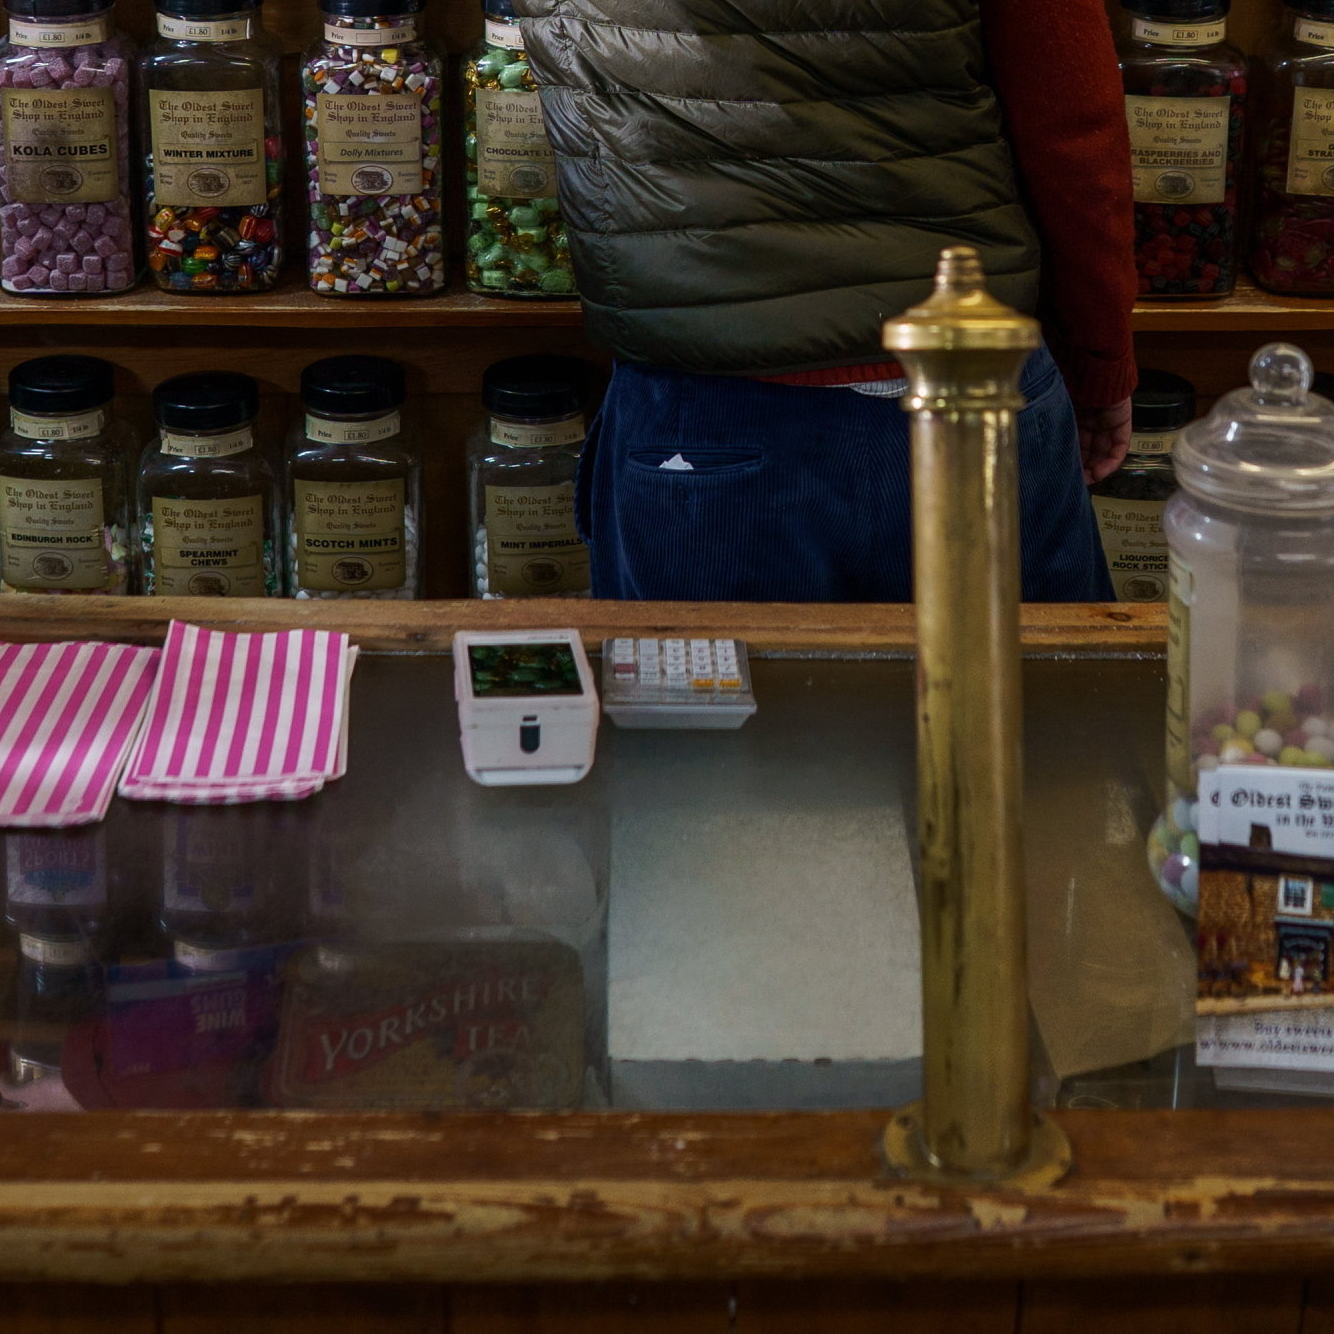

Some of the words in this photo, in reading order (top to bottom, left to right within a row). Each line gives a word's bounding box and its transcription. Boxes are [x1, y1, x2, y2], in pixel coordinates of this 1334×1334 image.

[13, 145, 54, 156] KOLA
[57, 144, 107, 156] CUBES
[164, 149, 203, 158] WINTER
[206, 147, 254, 158] MIXTURE
[340, 148, 363, 157] Dolly
[367, 148, 403, 157] Mixtures
[305, 539, 354, 549] SCOTCH
[358, 537, 398, 547] MINTS
[1231, 790, 1292, 809] Oldest
[1276, 814, 1292, 825] in
[1295, 815, 1317, 828] the
[319, 977, 537, 1071] YORKSHIRE
